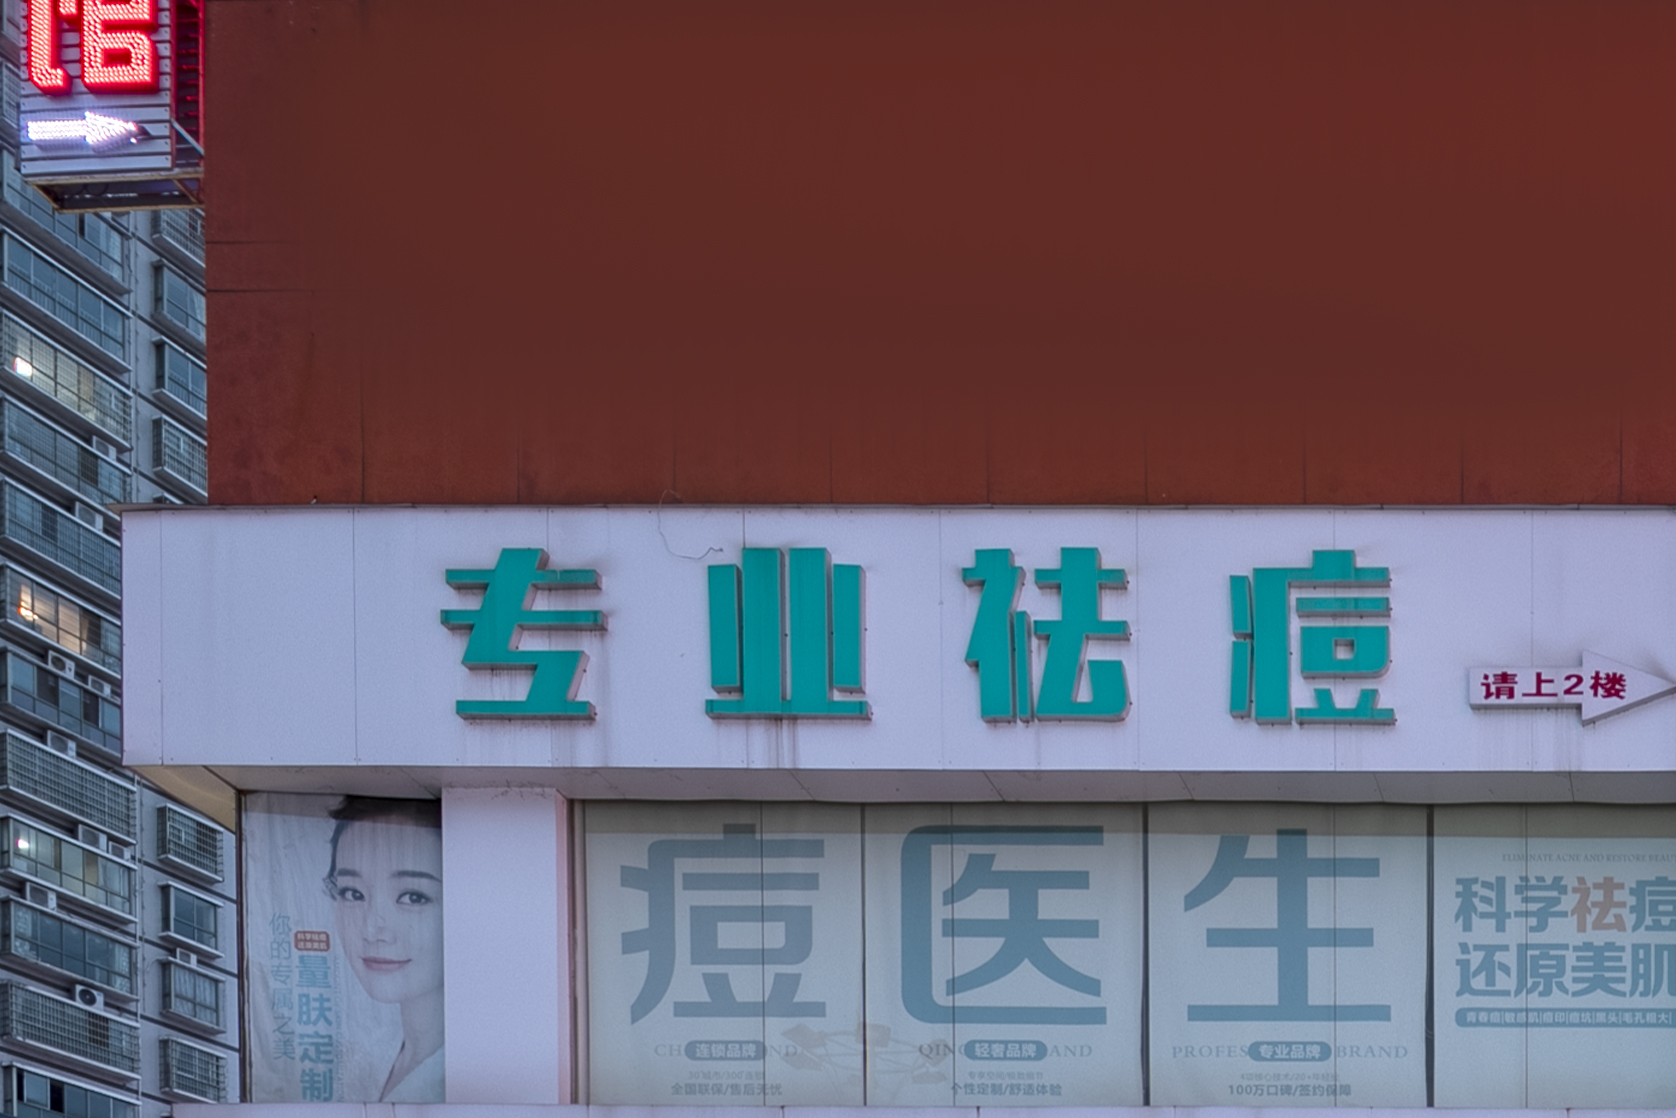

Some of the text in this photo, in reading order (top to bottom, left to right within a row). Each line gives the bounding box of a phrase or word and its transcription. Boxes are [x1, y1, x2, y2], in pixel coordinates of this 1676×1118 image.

[441, 548, 1397, 727] 专业祛痘
[1480, 670, 1627, 701] 请上2楼
[1556, 853, 1581, 863] ACNE
[1583, 853, 1604, 863] AND
[1606, 853, 1647, 863] RESTORE
[620, 823, 1391, 1028] 痘医生
[268, 911, 296, 1061] 你的专属之美
[295, 955, 334, 1102] 量肤定制
[695, 1043, 758, 1059] 连锁品牌
[974, 1042, 1037, 1058] 轻奢品牌
[1259, 1044, 1322, 1060] 专业品牌
[671, 1082, 783, 1096] 全国联保/售后无忧
[951, 1083, 1063, 1096] 个性定制/舒适体验
